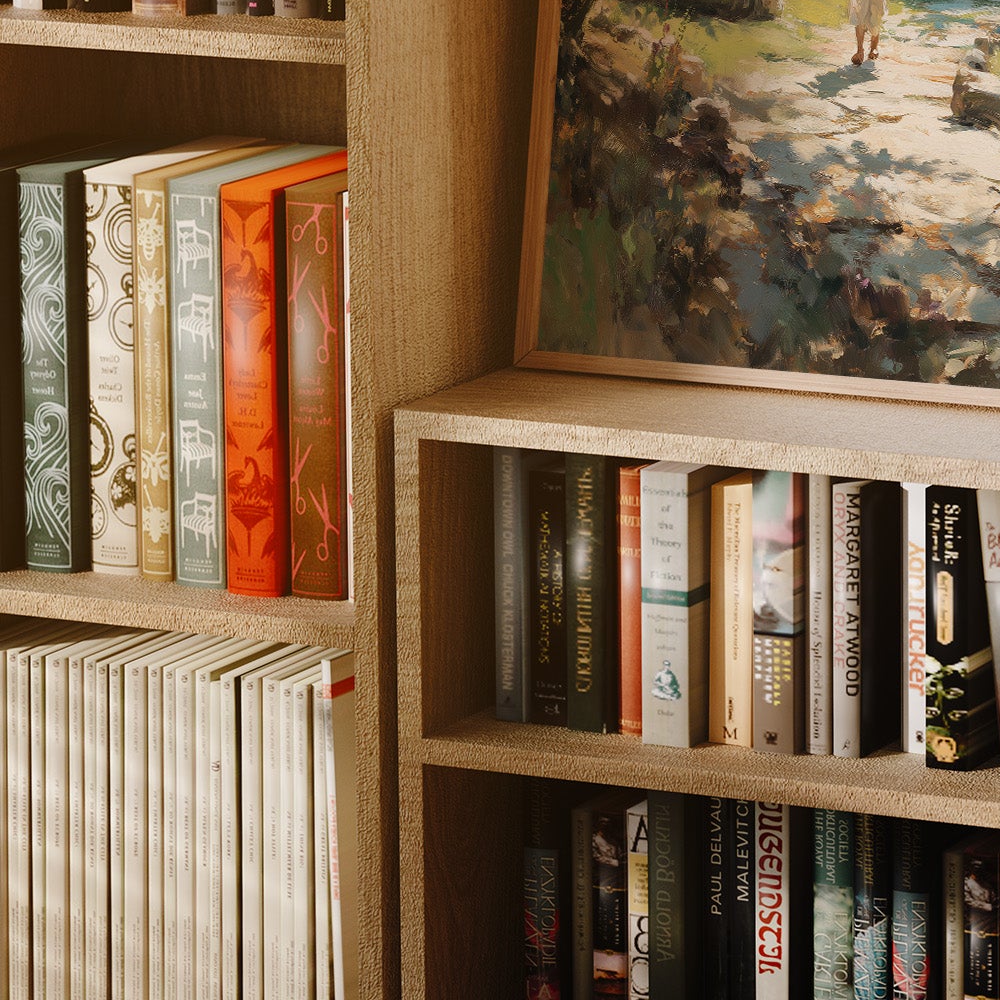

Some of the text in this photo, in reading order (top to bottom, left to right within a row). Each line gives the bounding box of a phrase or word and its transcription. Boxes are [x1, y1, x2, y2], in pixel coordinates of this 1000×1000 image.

[649, 537, 682, 550] Theory
[833, 493, 846, 542] ORYX
[501, 455, 514, 690] DOWNTOWN OWL CHUCK KLOSTERMAN
[650, 571, 682, 582] Fiction
[845, 494, 861, 697] MARGARET ATWOOD
[813, 591, 823, 622] House
[834, 608, 846, 669] CRAKE
[710, 798, 723, 915] PAUL DELVAU
[758, 801, 783, 974] JUGENDSTIL
